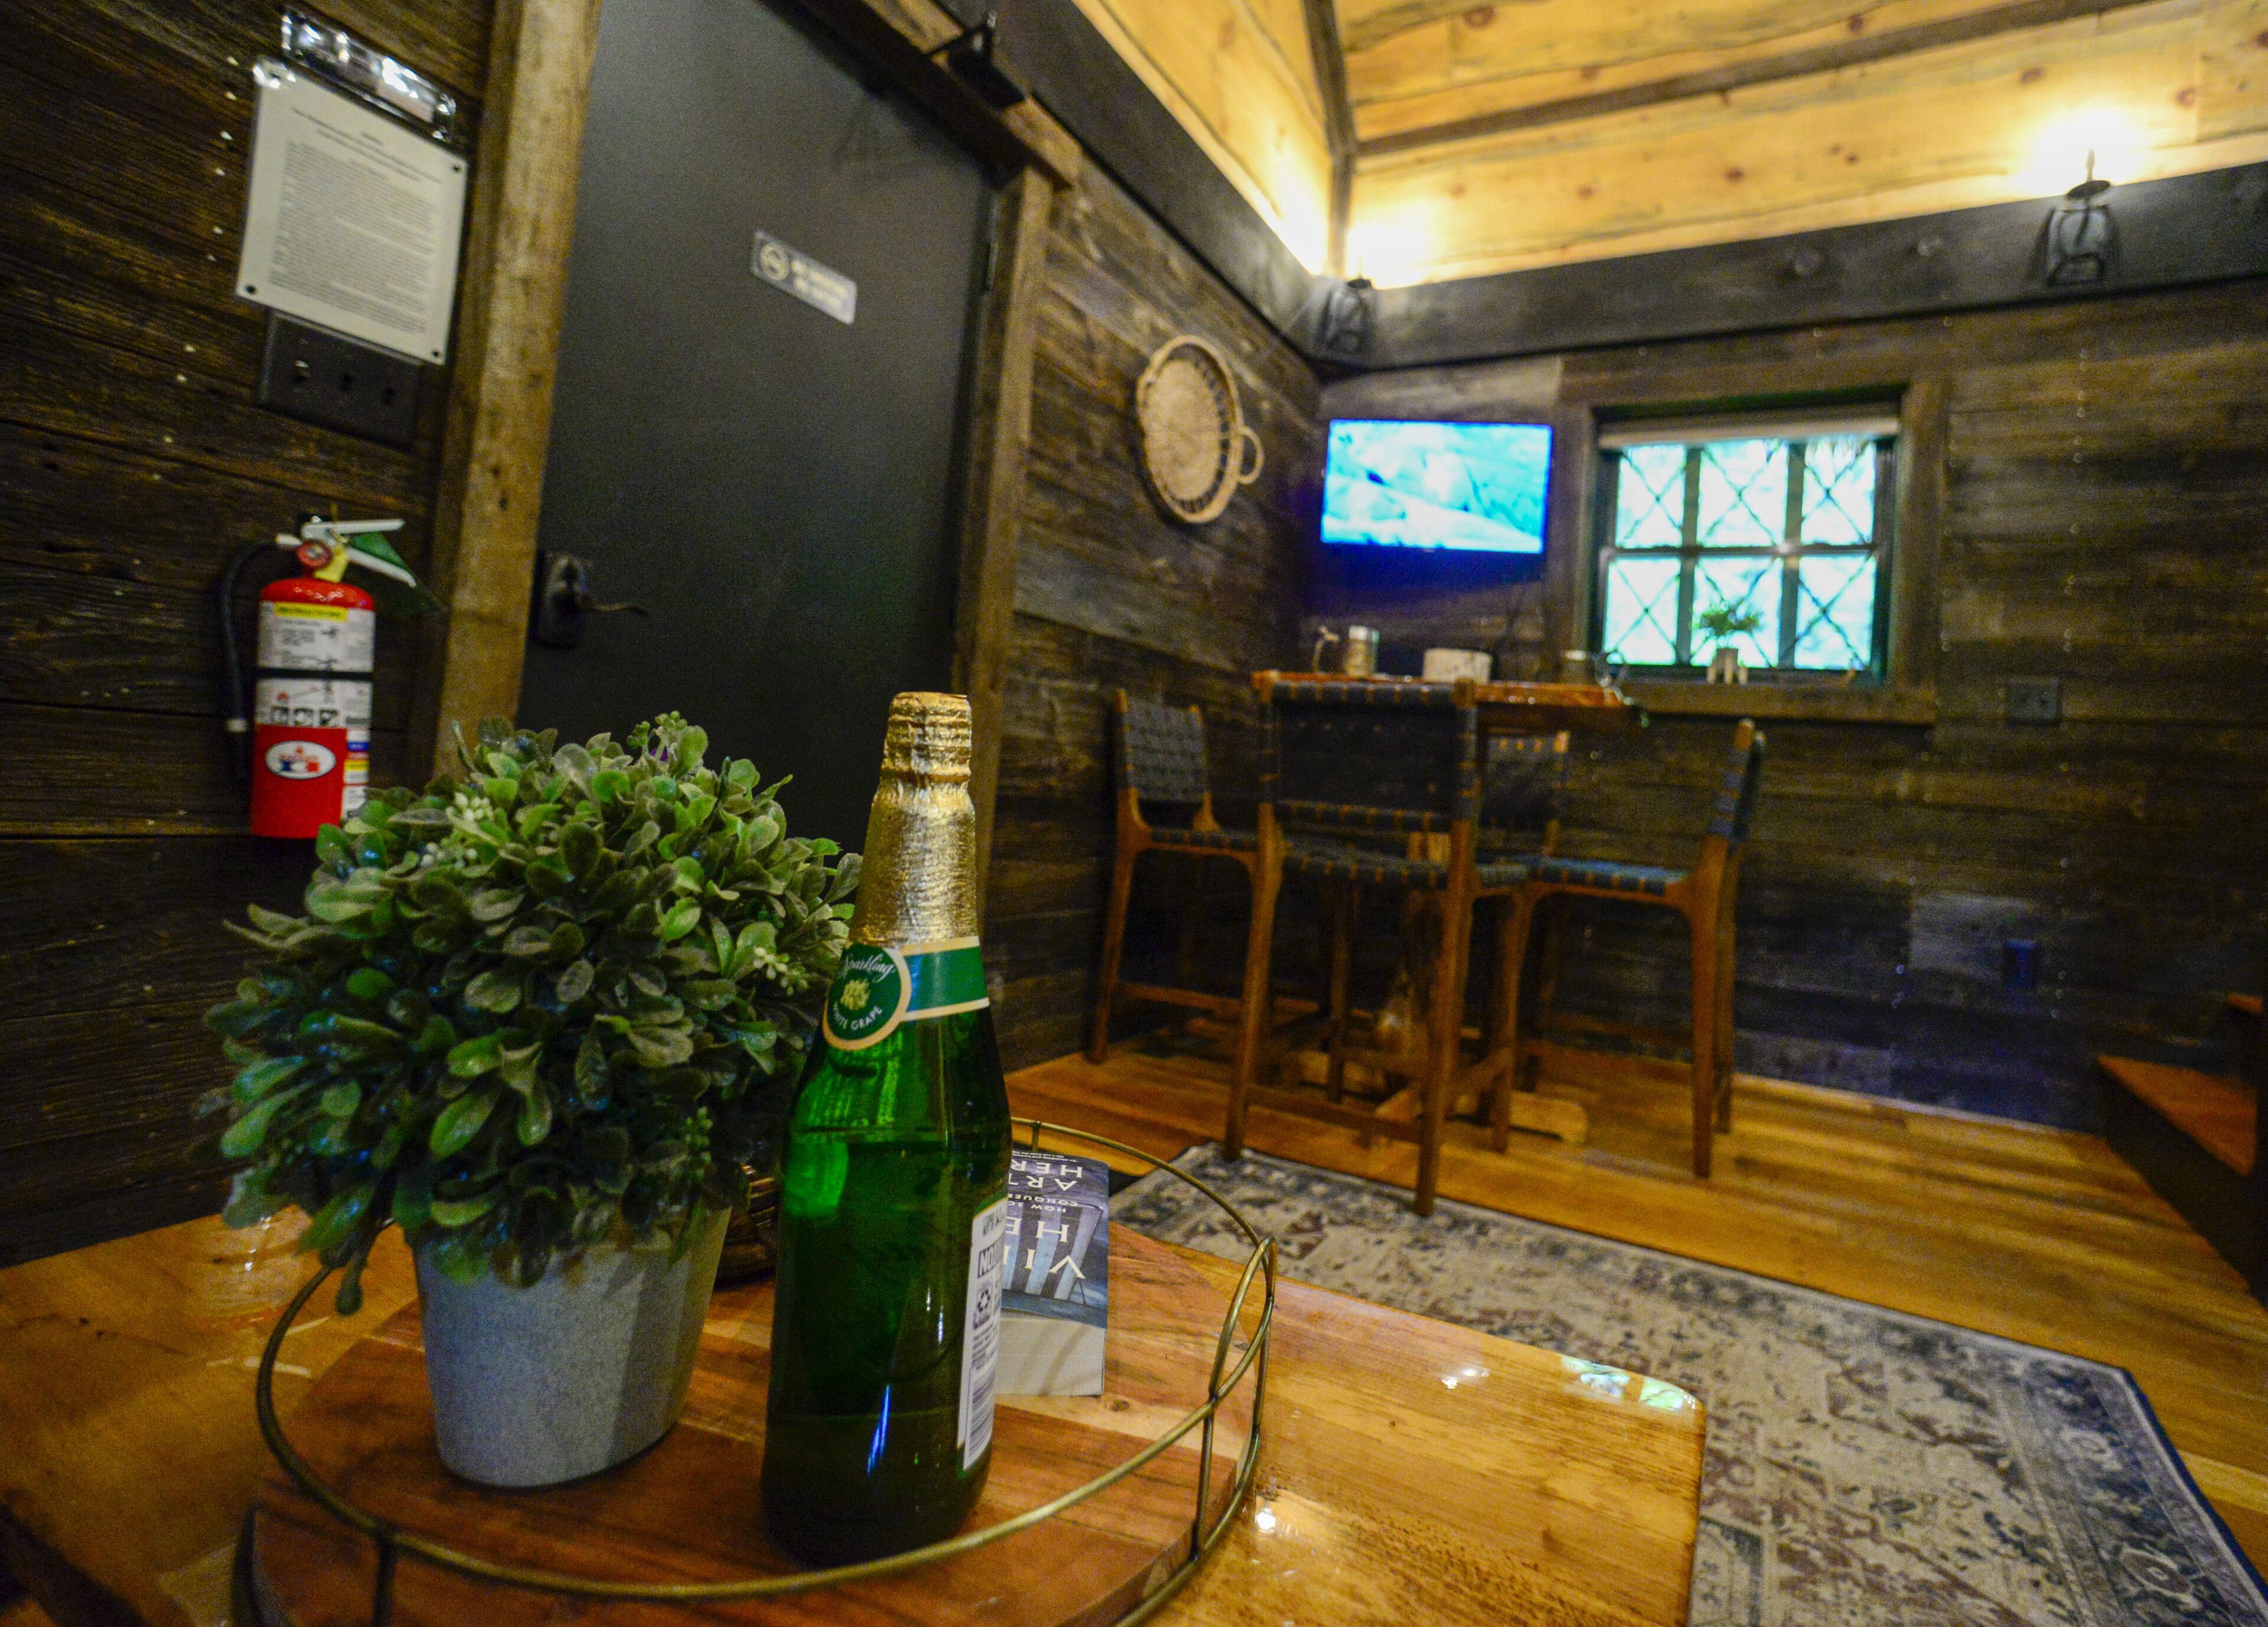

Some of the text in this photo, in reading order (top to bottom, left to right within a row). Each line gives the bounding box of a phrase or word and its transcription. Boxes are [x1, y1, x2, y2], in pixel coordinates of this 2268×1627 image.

[838, 953, 896, 983] Sparkling
[850, 1005, 883, 1031] GRAPE
[1031, 1203, 1067, 1213] HOW
